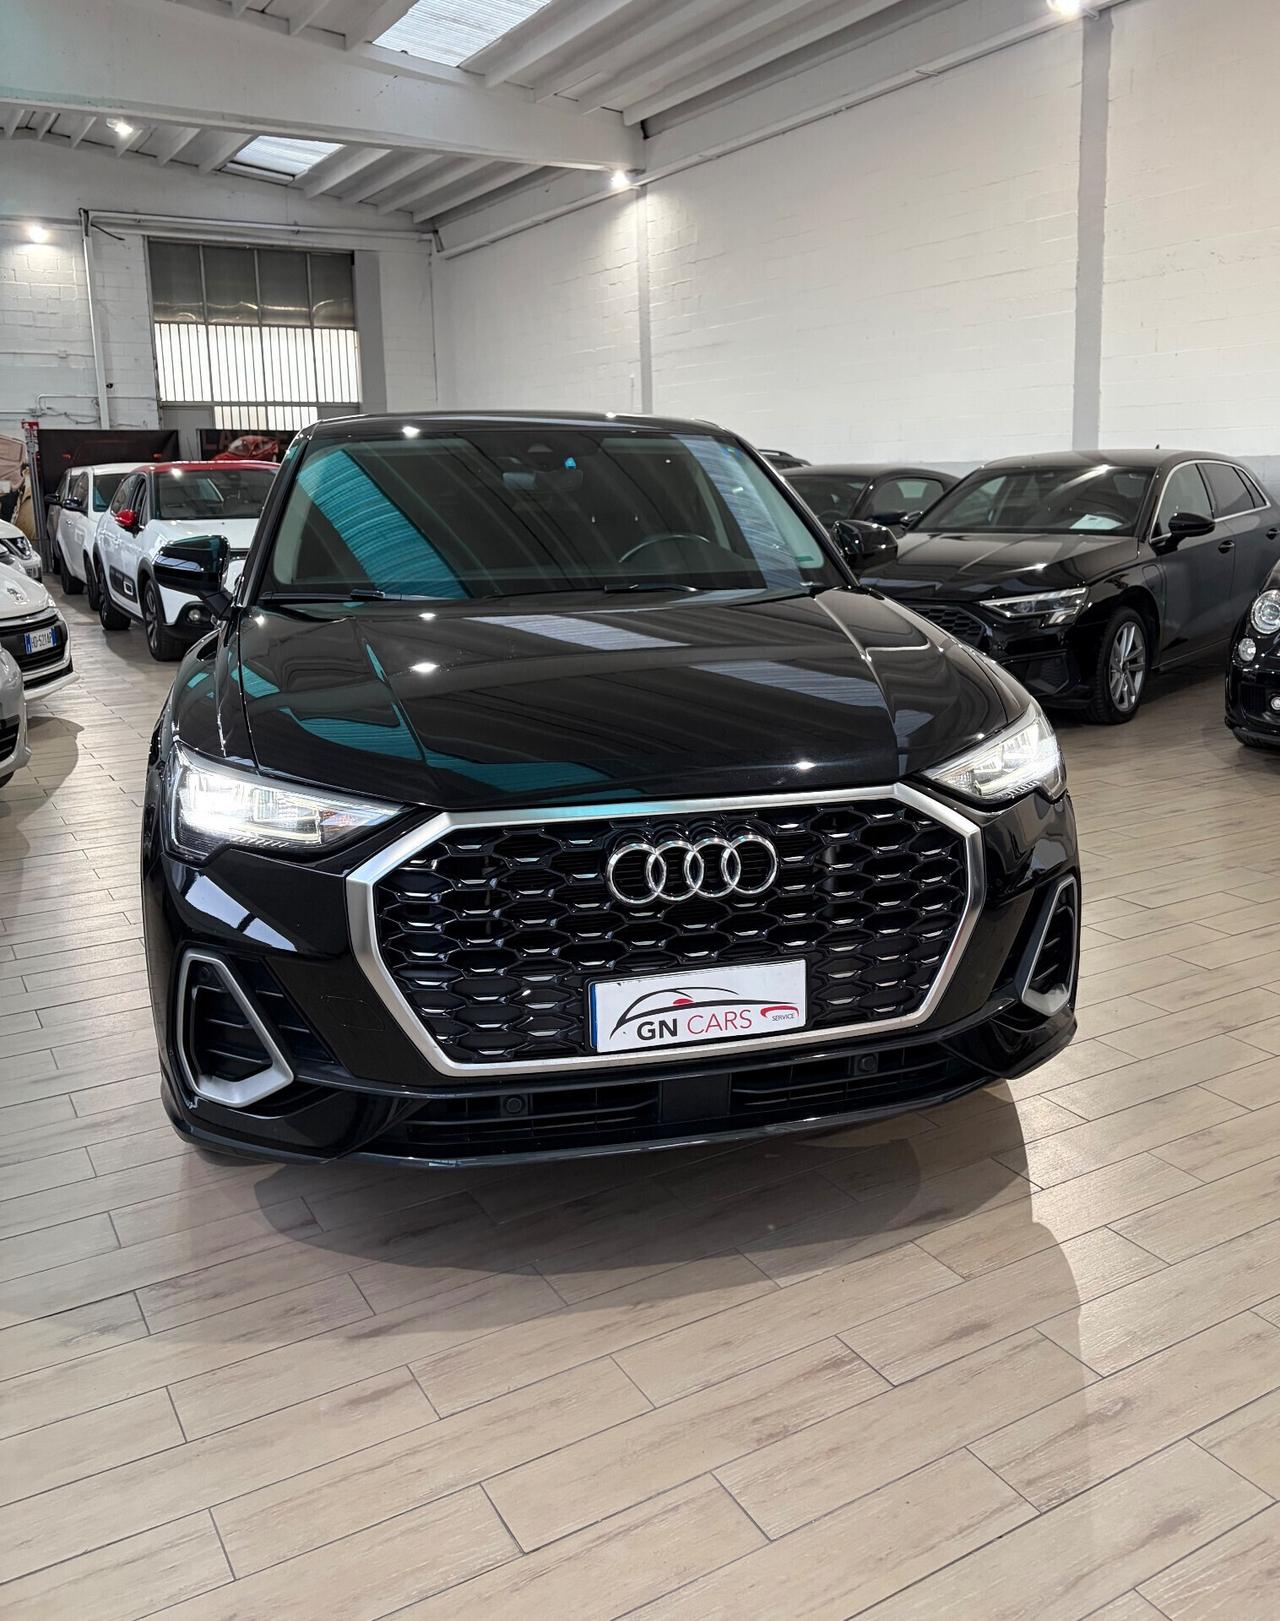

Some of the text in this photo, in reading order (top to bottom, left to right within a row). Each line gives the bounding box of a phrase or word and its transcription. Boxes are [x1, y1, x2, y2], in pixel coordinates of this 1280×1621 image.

[636, 1009, 753, 1041] GN CARS
[771, 1012, 796, 1022] SERVICE
